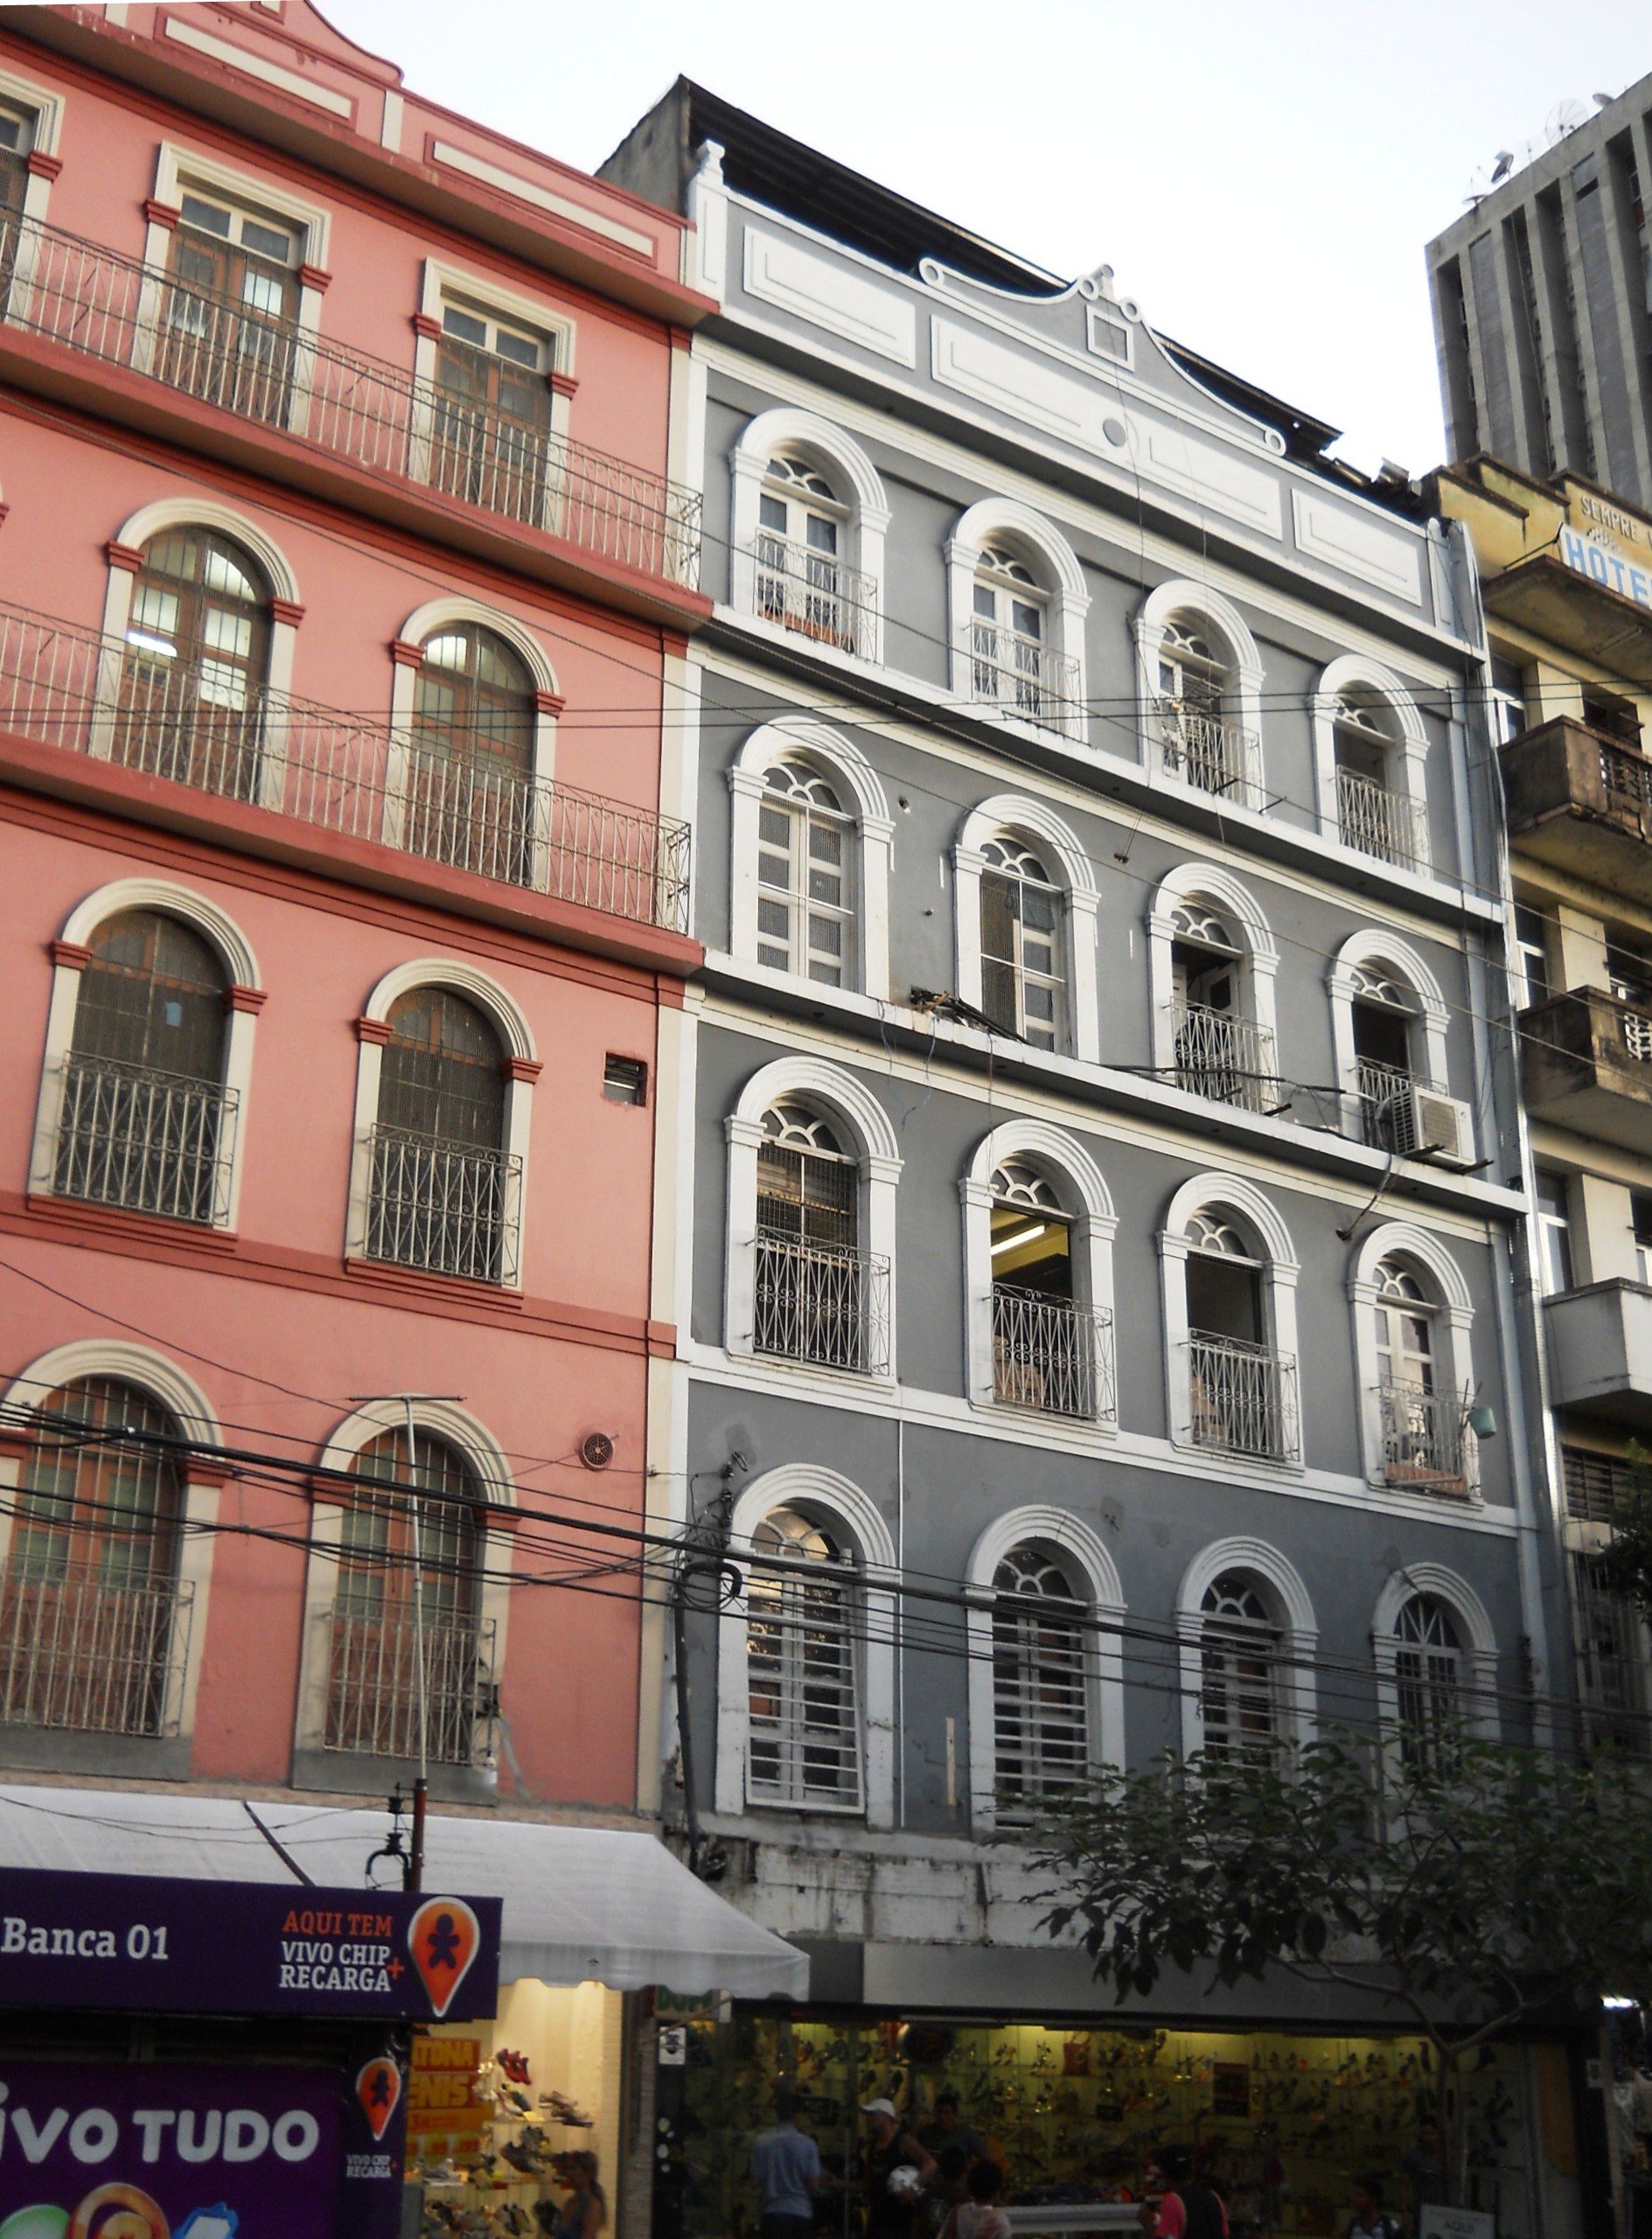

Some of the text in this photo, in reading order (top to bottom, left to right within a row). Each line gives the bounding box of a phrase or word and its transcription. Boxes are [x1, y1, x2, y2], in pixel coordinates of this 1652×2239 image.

[1580, 495, 1639, 543] SEMPRE
[1565, 532, 1652, 609] HOTE
[0, 1917, 169, 1960] Banca 01
[282, 1910, 393, 1937] AQUI TEM
[281, 1941, 391, 1966] VIVO CHIP
[279, 1964, 392, 1992] RECARGA
[133, 2109, 320, 2165] TUDO
